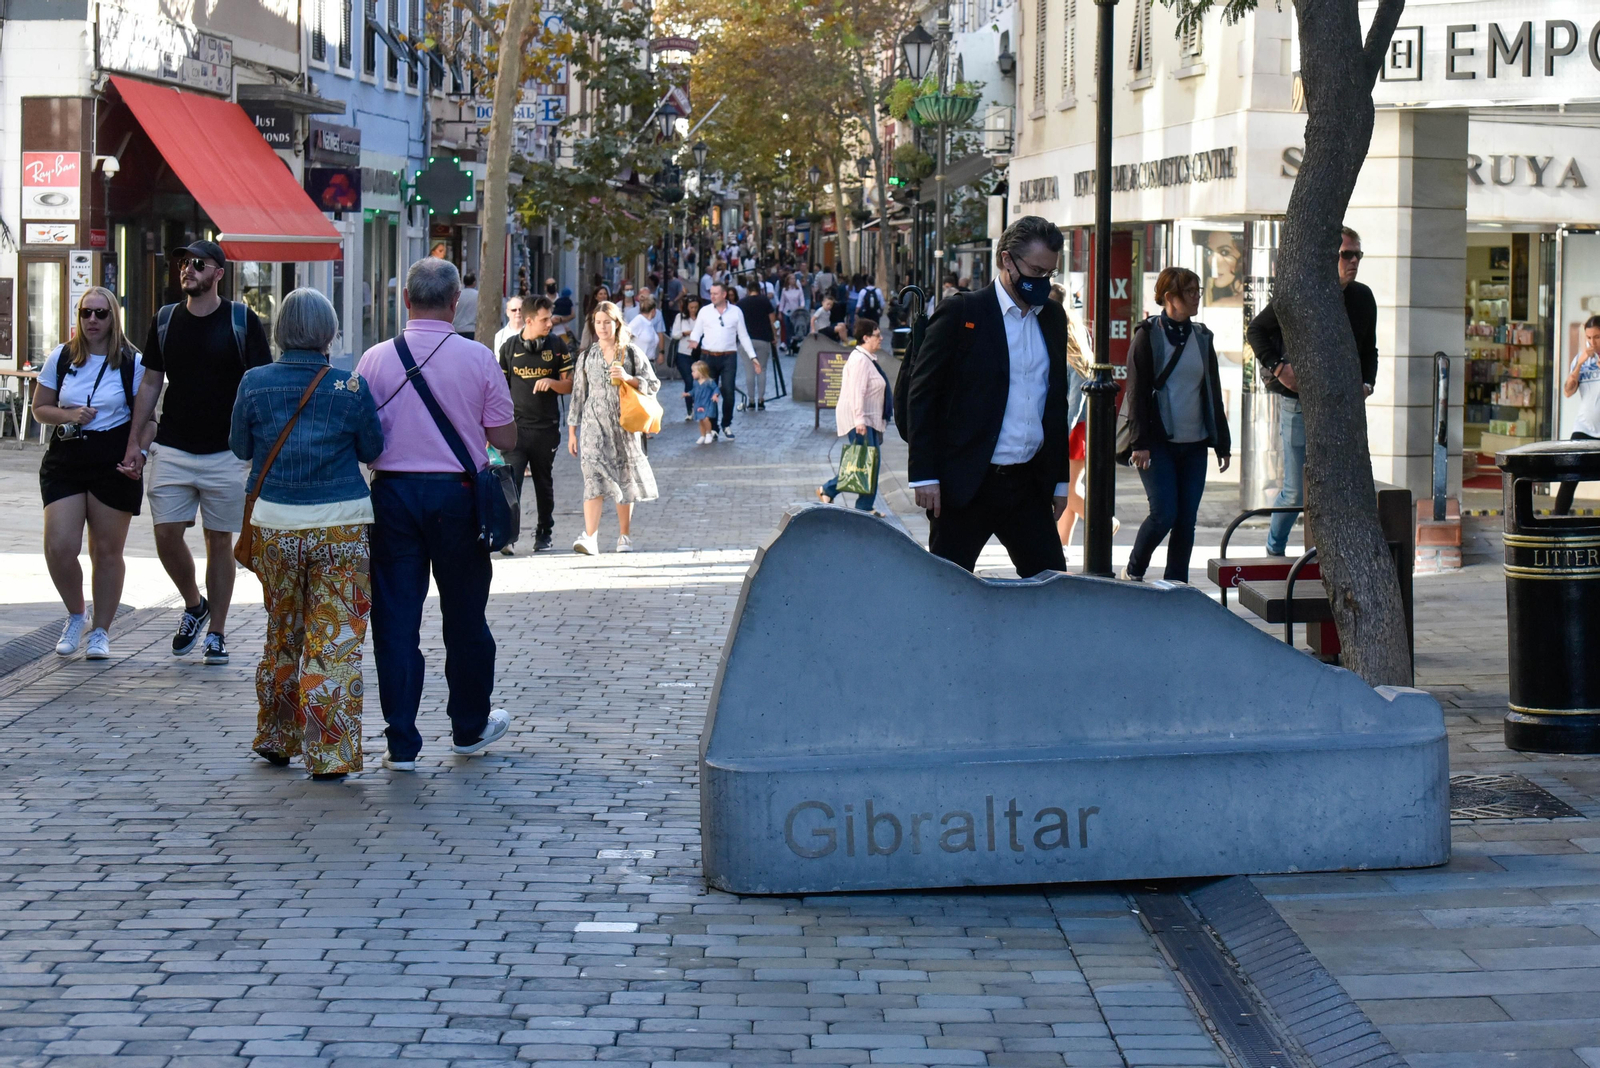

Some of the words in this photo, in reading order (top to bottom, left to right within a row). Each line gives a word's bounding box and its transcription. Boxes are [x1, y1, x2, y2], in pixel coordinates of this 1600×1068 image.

[1446, 20, 1600, 80] EMP
[255, 114, 275, 127] JUST
[1192, 146, 1238, 183] CENTRE
[513, 366, 552, 376] Rakuten
[1533, 549, 1599, 567] LITTER
[784, 795, 1100, 859] Gibraltar
